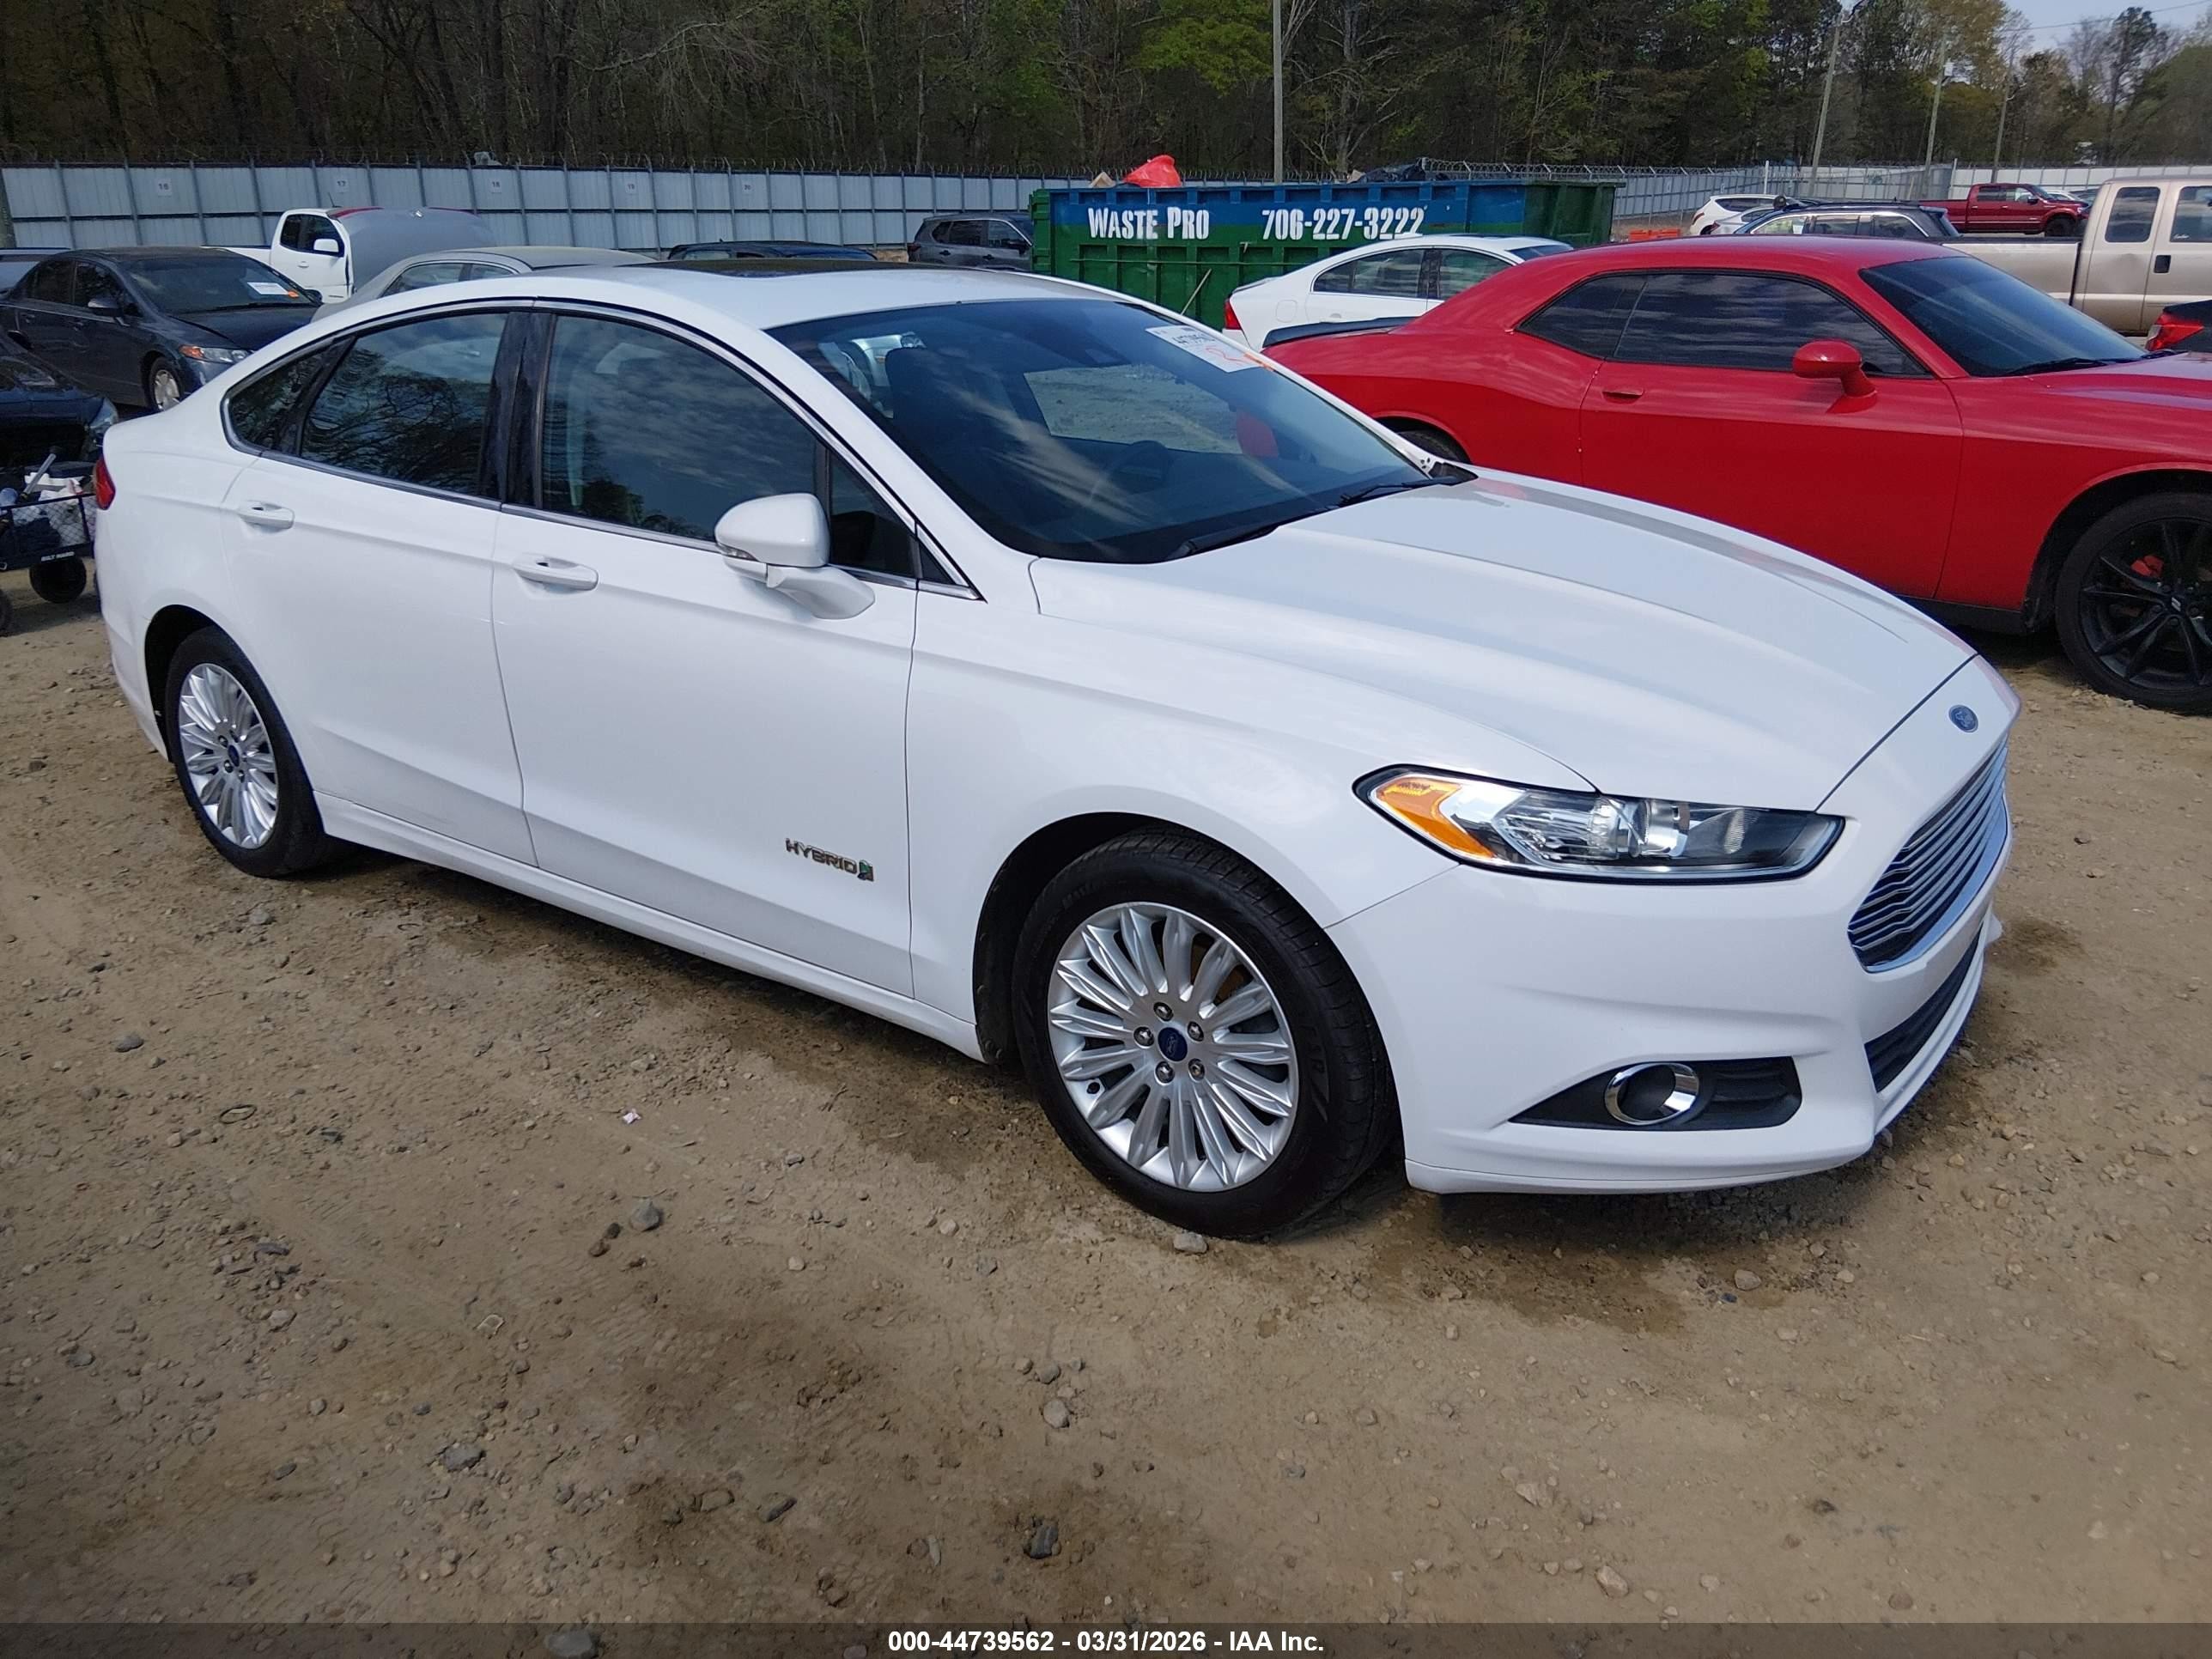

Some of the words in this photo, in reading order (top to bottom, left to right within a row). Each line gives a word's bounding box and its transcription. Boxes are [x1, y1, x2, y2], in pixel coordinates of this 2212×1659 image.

[1088, 207, 1158, 240] WASTE
[1167, 207, 1210, 240] PRO
[1261, 207, 1425, 240] 706-227-3222
[785, 838, 858, 874] HYBRID
